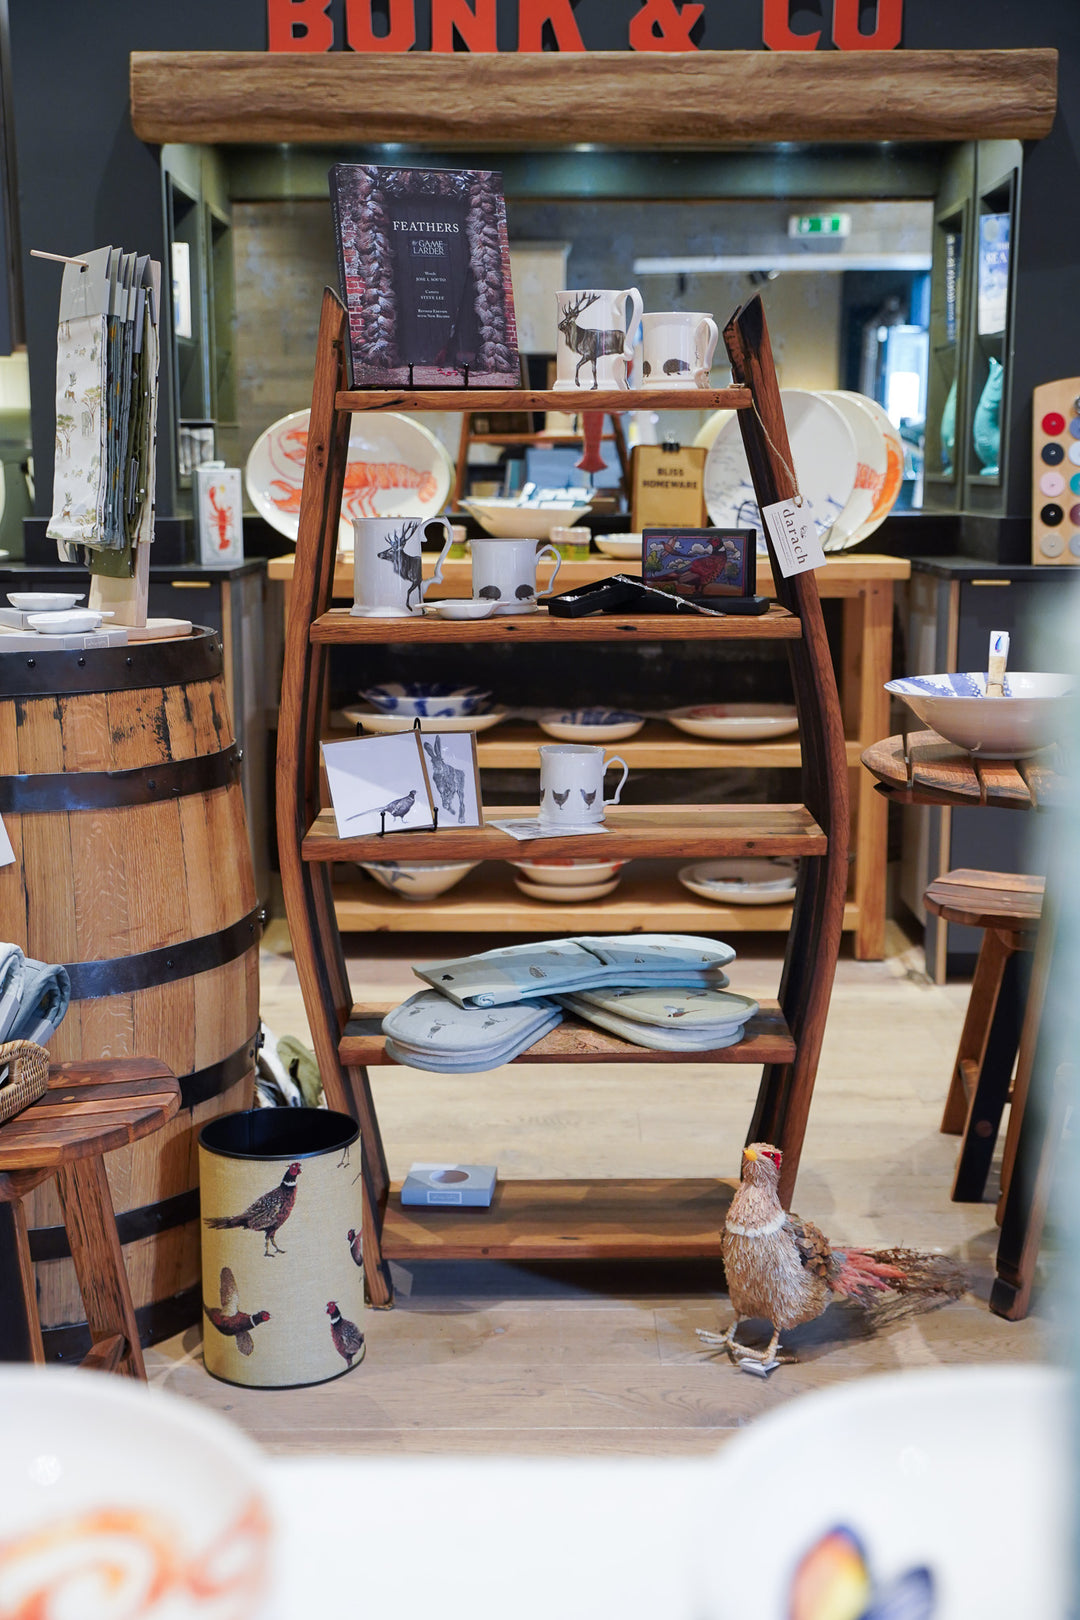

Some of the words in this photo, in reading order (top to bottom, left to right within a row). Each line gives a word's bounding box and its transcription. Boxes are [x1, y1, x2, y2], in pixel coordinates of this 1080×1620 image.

[393, 221, 460, 233] FEATHERS
[418, 240, 444, 248] GAME
[413, 246, 445, 255] LARDER
[657, 468, 684, 477] BLISS
[642, 479, 697, 489] HOMEWARE
[782, 508, 808, 565] darach
